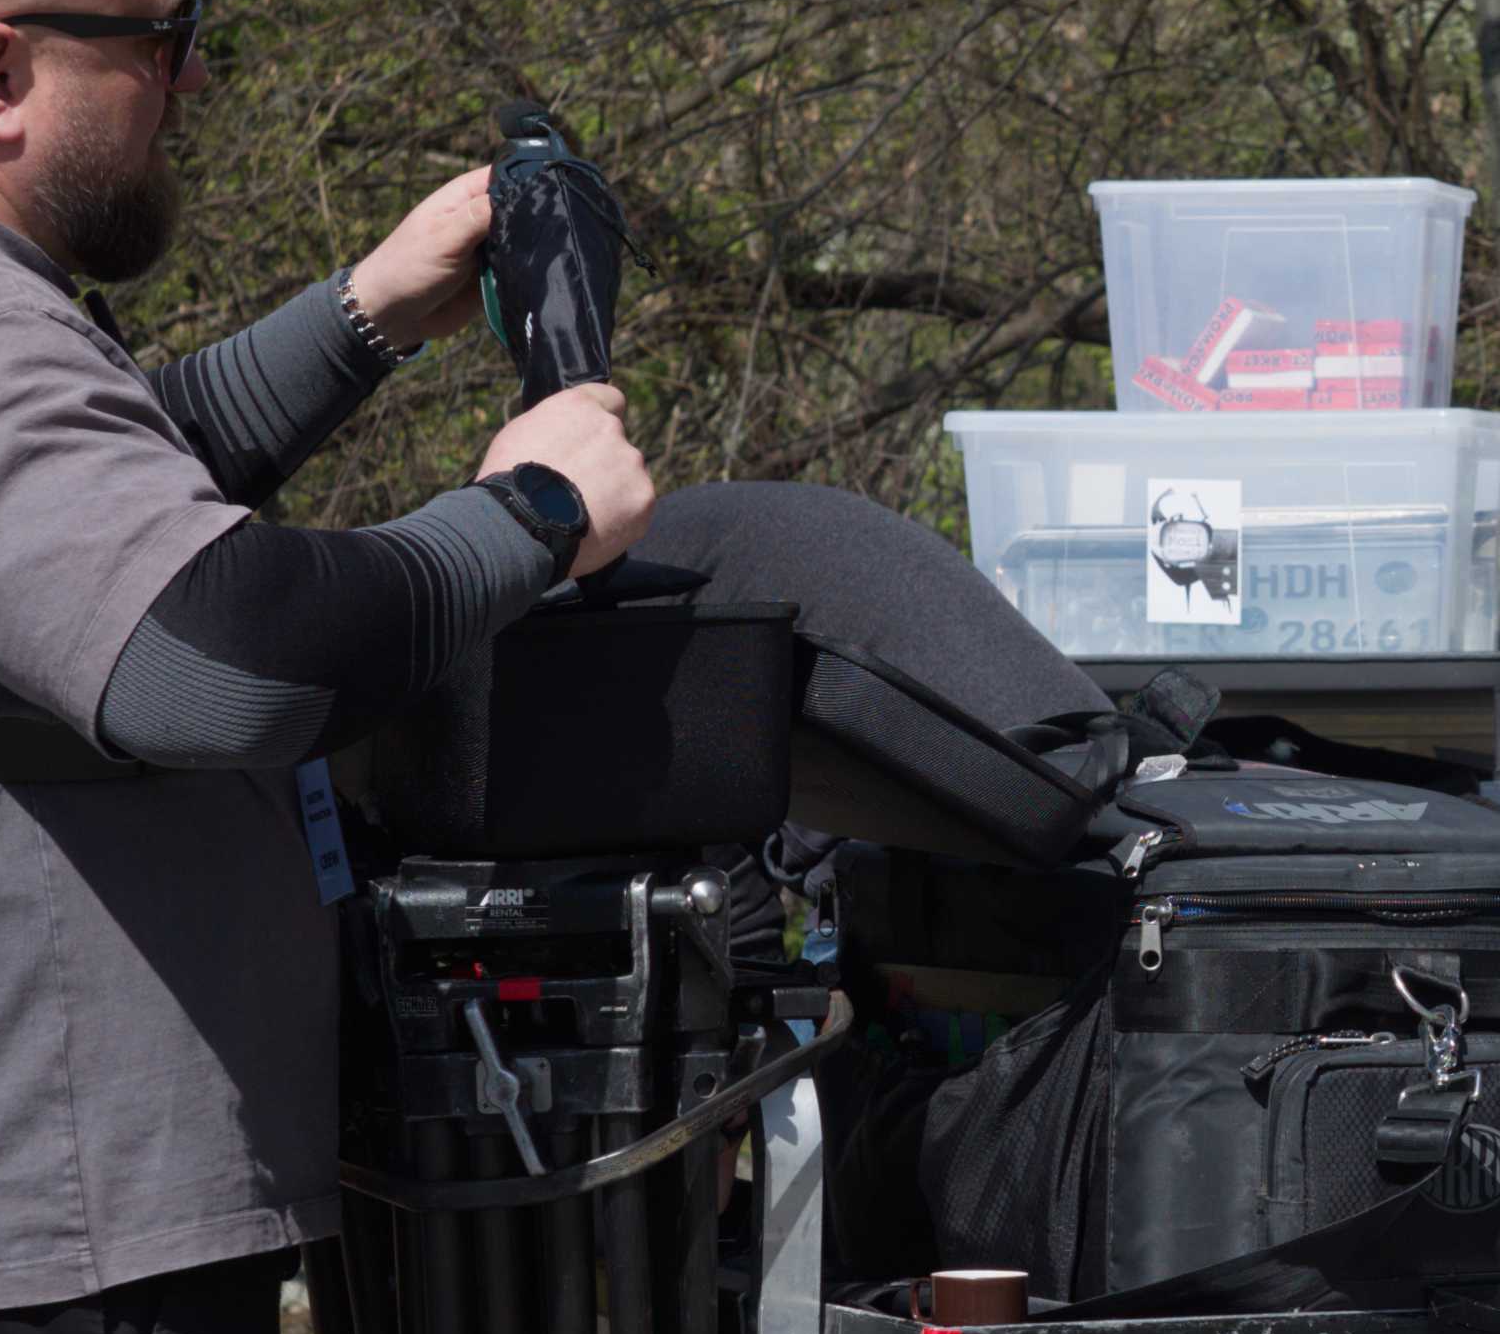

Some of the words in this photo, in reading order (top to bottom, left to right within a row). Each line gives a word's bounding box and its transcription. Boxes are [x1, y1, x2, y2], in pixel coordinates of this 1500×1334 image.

[1253, 799, 1429, 824] ARRI
[479, 889, 524, 907] ARRI
[490, 908, 525, 918] RENTAL
